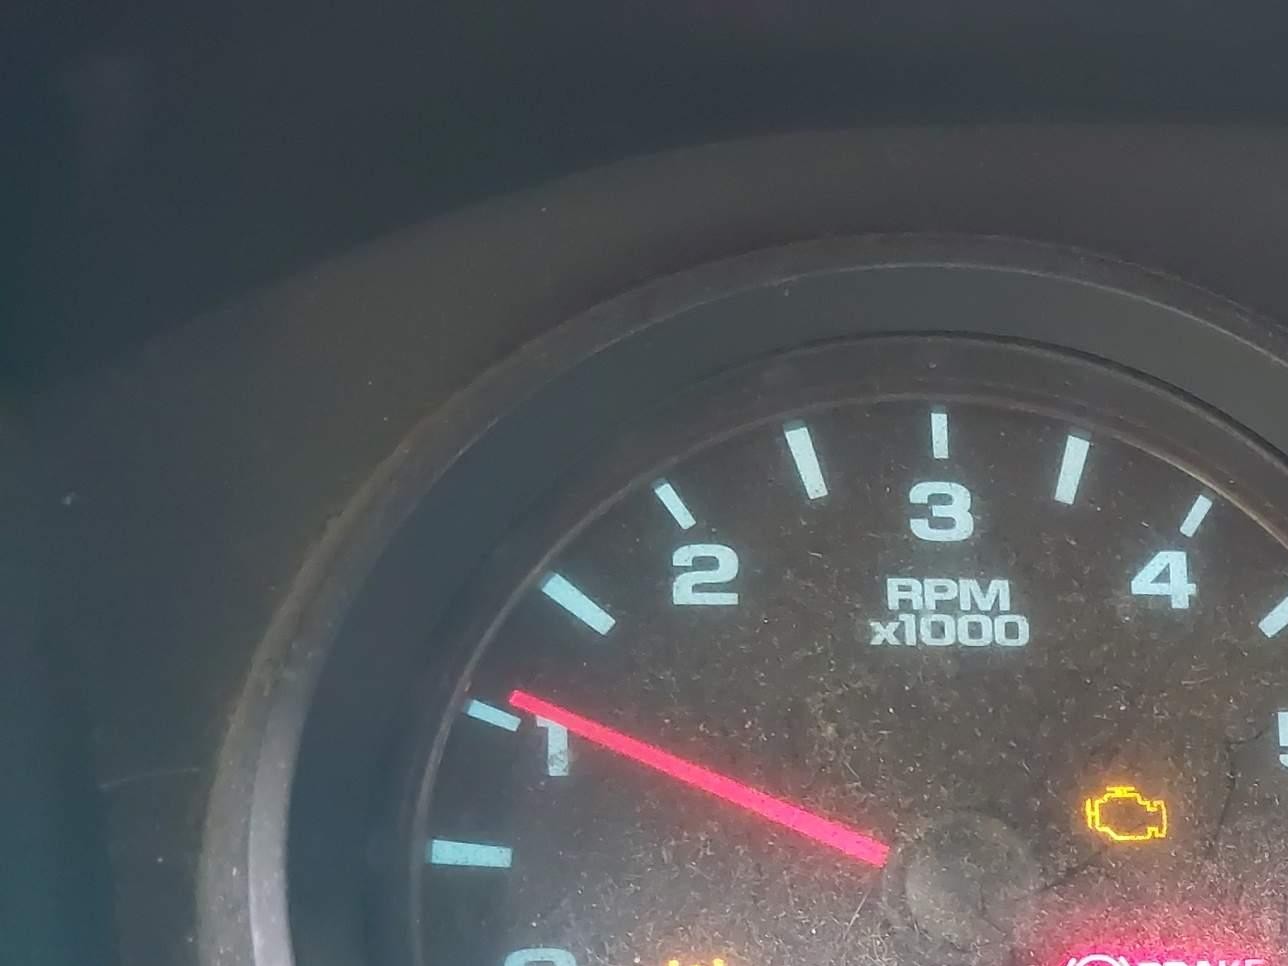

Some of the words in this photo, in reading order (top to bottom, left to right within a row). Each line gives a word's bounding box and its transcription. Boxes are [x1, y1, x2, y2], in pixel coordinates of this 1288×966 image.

[908, 481, 975, 542] 3
[672, 544, 739, 606] 2
[886, 578, 1010, 611] RPM
[1131, 551, 1196, 609] 4
[870, 614, 1030, 647] x1000
